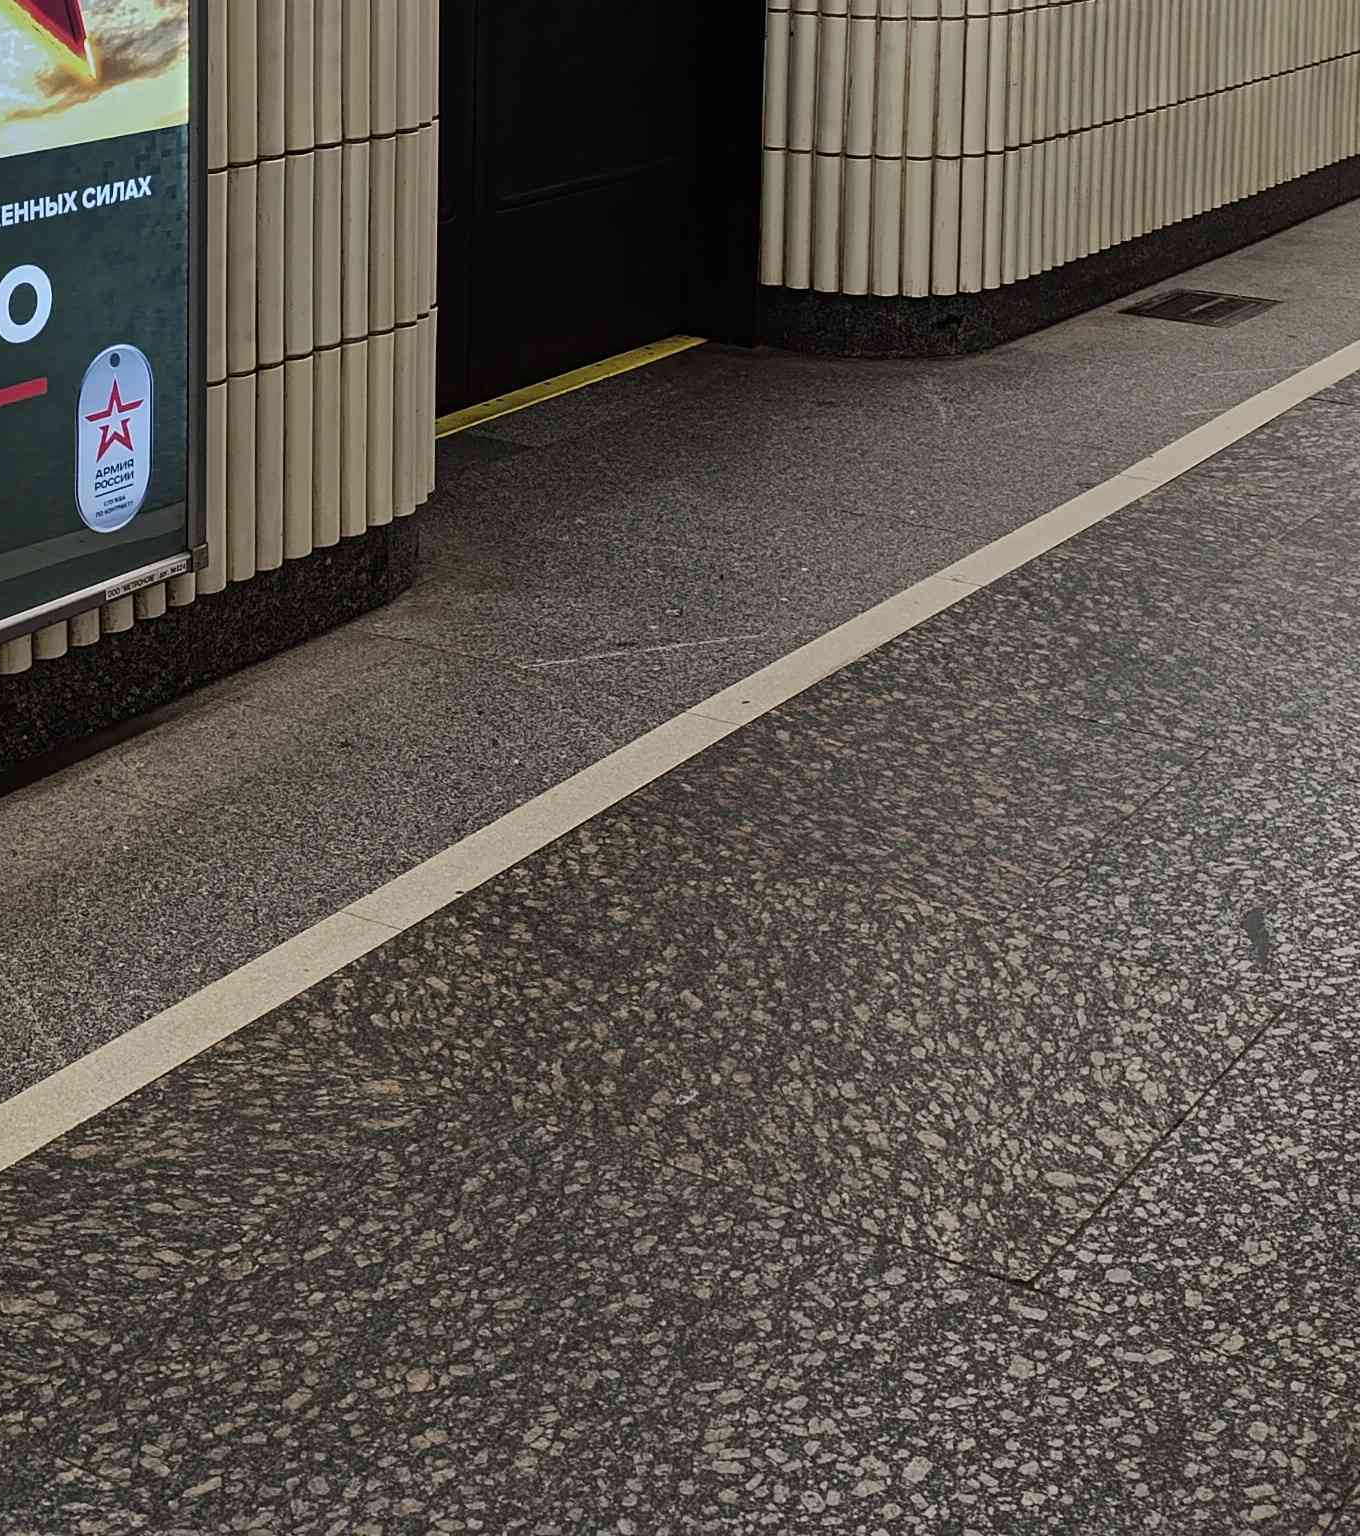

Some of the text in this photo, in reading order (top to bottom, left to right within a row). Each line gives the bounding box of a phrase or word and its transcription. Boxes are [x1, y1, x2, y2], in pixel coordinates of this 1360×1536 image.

[81, 175, 152, 209] СИЛАХ
[96, 458, 134, 479] АРМИЯ
[95, 470, 134, 491] РОССИИ
